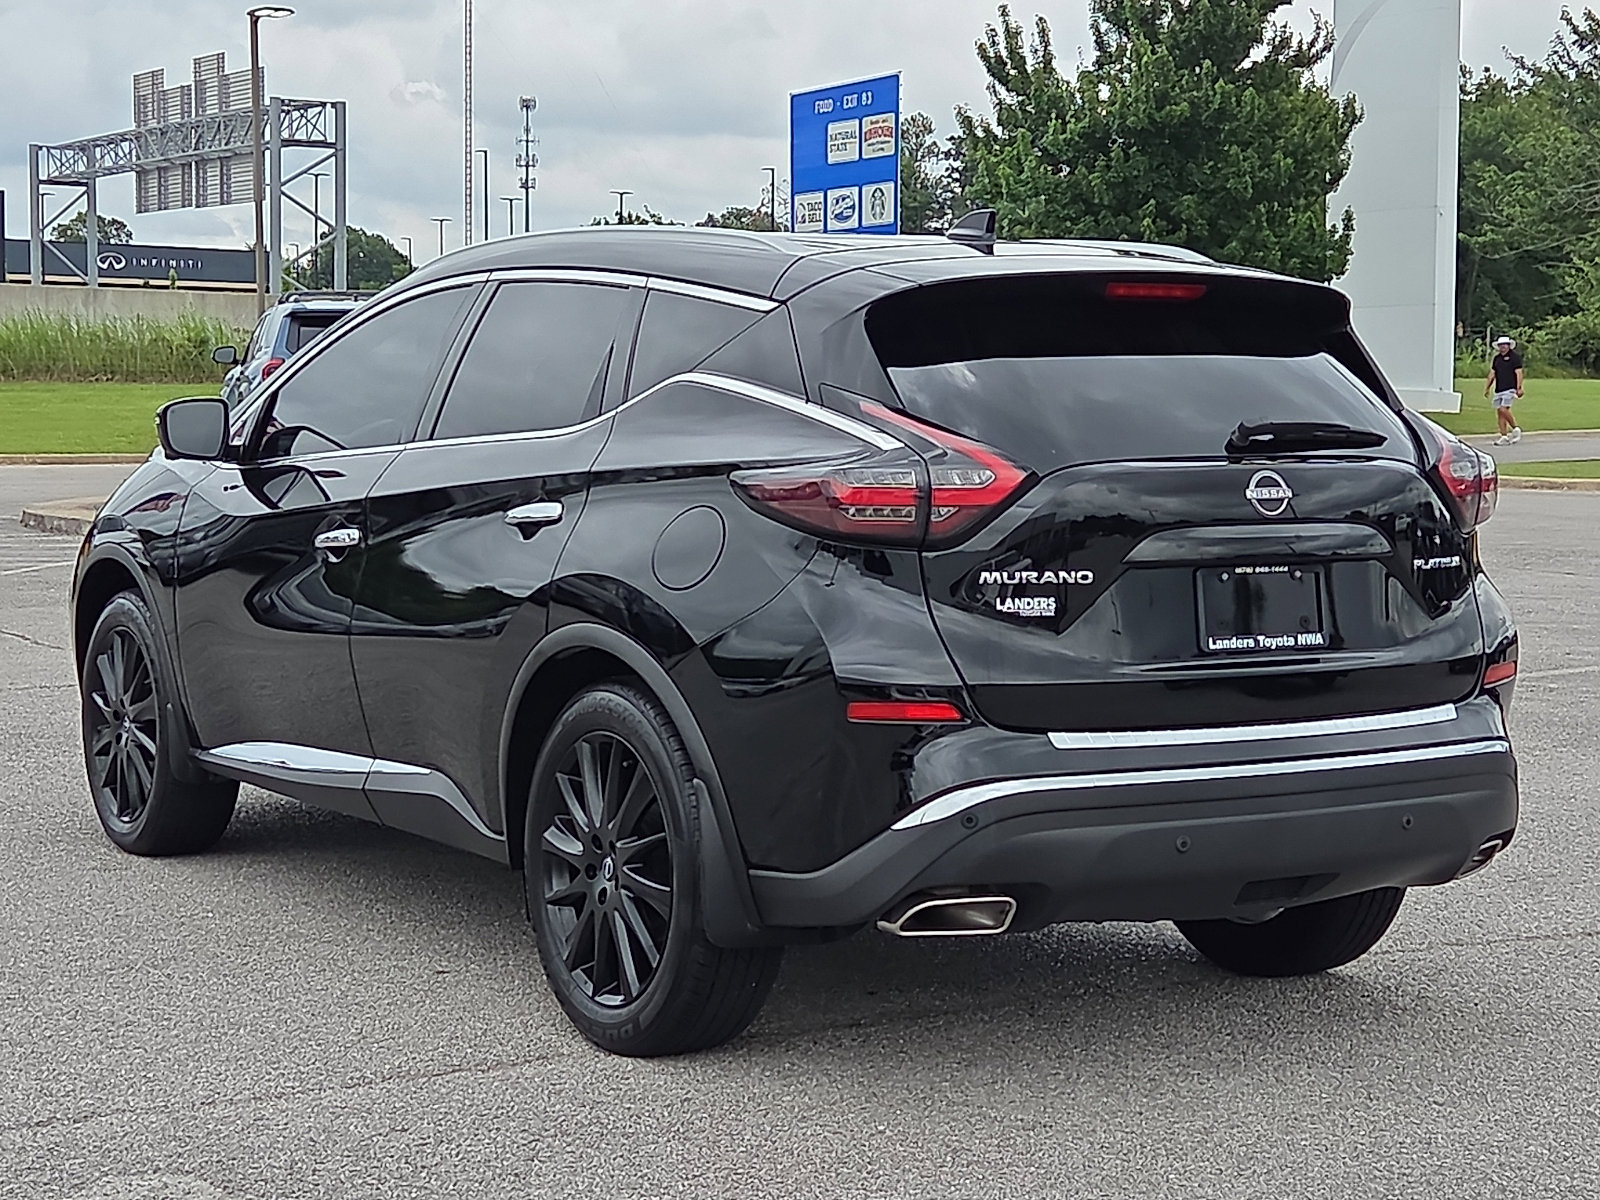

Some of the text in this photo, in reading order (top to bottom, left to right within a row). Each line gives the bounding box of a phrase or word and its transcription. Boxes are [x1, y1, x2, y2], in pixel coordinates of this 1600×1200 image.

[815, 99, 833, 114] FOOD
[843, 94, 858, 109] EXIT
[861, 91, 872, 106] 83
[829, 142, 848, 154] STATE
[132, 257, 202, 269] INFINITI
[1245, 486, 1293, 500] NISSAN
[979, 571, 1093, 584] MURANO
[996, 597, 1056, 610] LANDERS
[1209, 632, 1324, 650] Landers Toyota NWA
